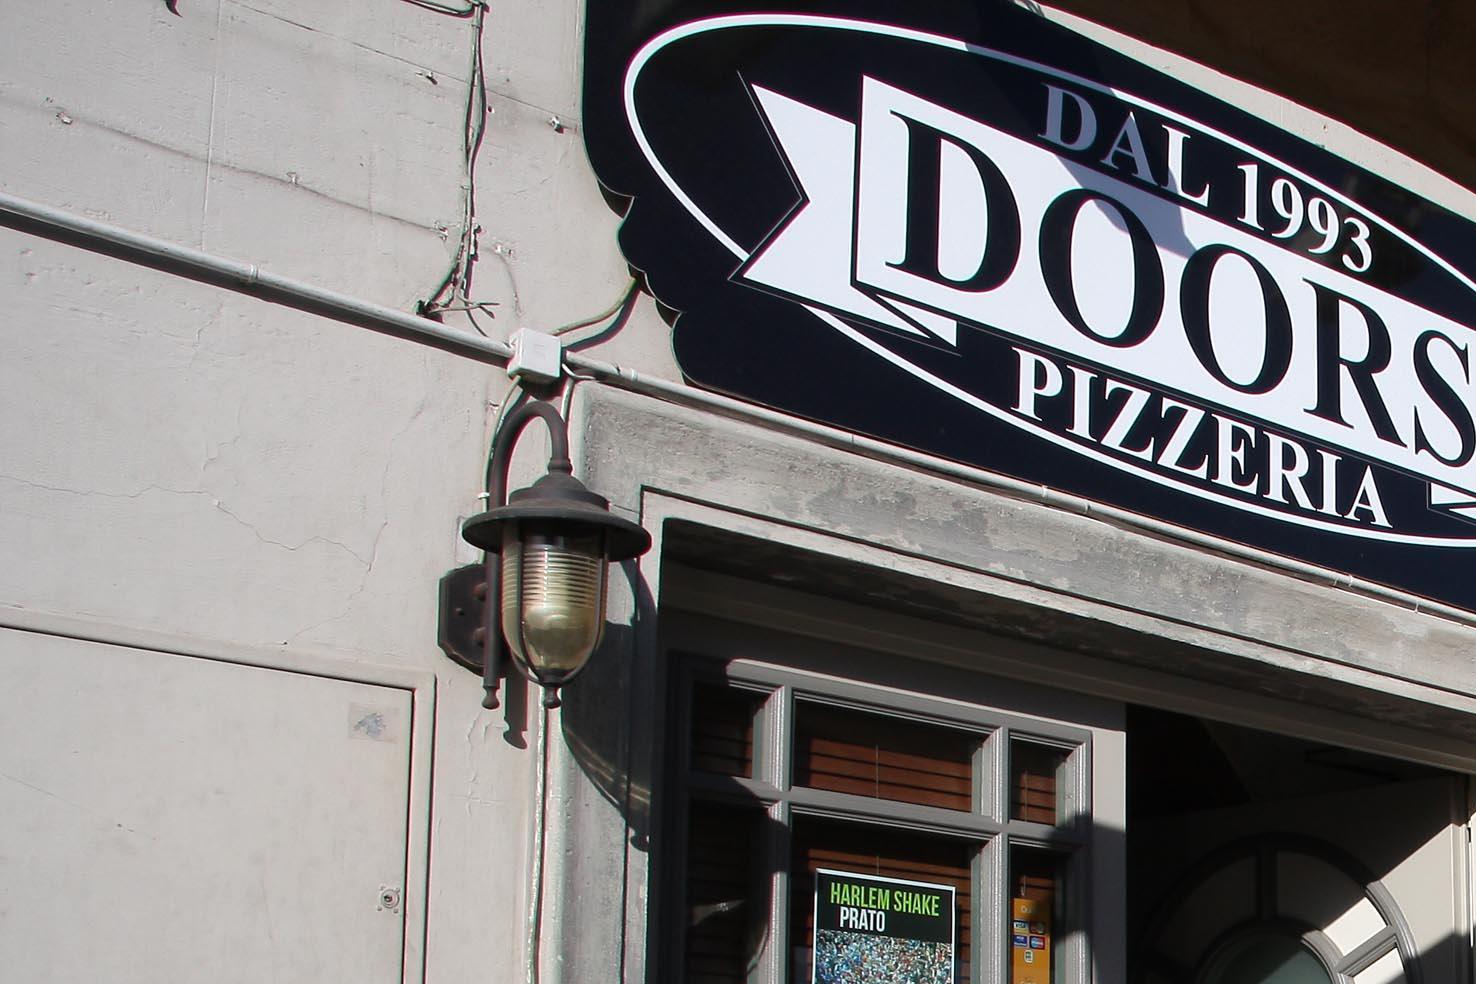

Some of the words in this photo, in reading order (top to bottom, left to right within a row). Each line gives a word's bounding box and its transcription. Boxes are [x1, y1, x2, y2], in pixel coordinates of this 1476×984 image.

[1037, 82, 1213, 208] DAL
[1234, 161, 1374, 274] 1993
[1011, 346, 1395, 531] PIZZERIA
[830, 882, 890, 911] HARLEM
[893, 890, 940, 917] SHAKE
[840, 906, 886, 932] PRATO
